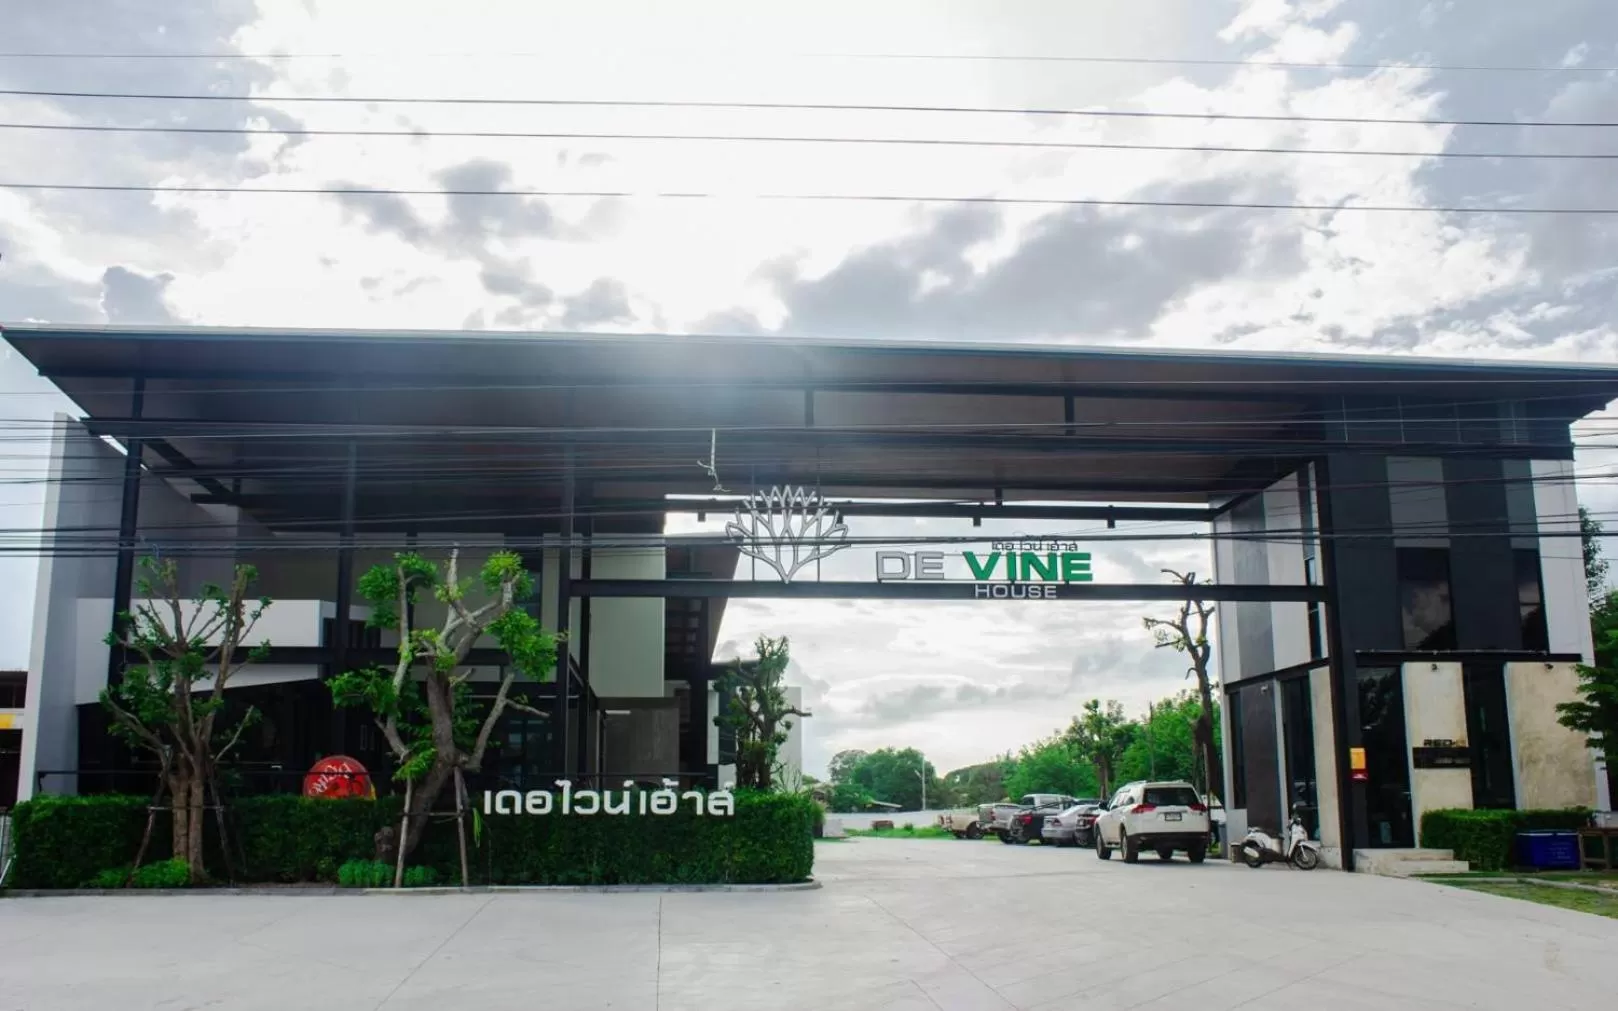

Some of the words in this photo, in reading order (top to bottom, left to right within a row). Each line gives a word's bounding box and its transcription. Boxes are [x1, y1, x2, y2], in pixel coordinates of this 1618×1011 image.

[876, 551, 944, 580] DE
[963, 551, 1093, 581] VINE
[975, 584, 1057, 599] HOUSE
